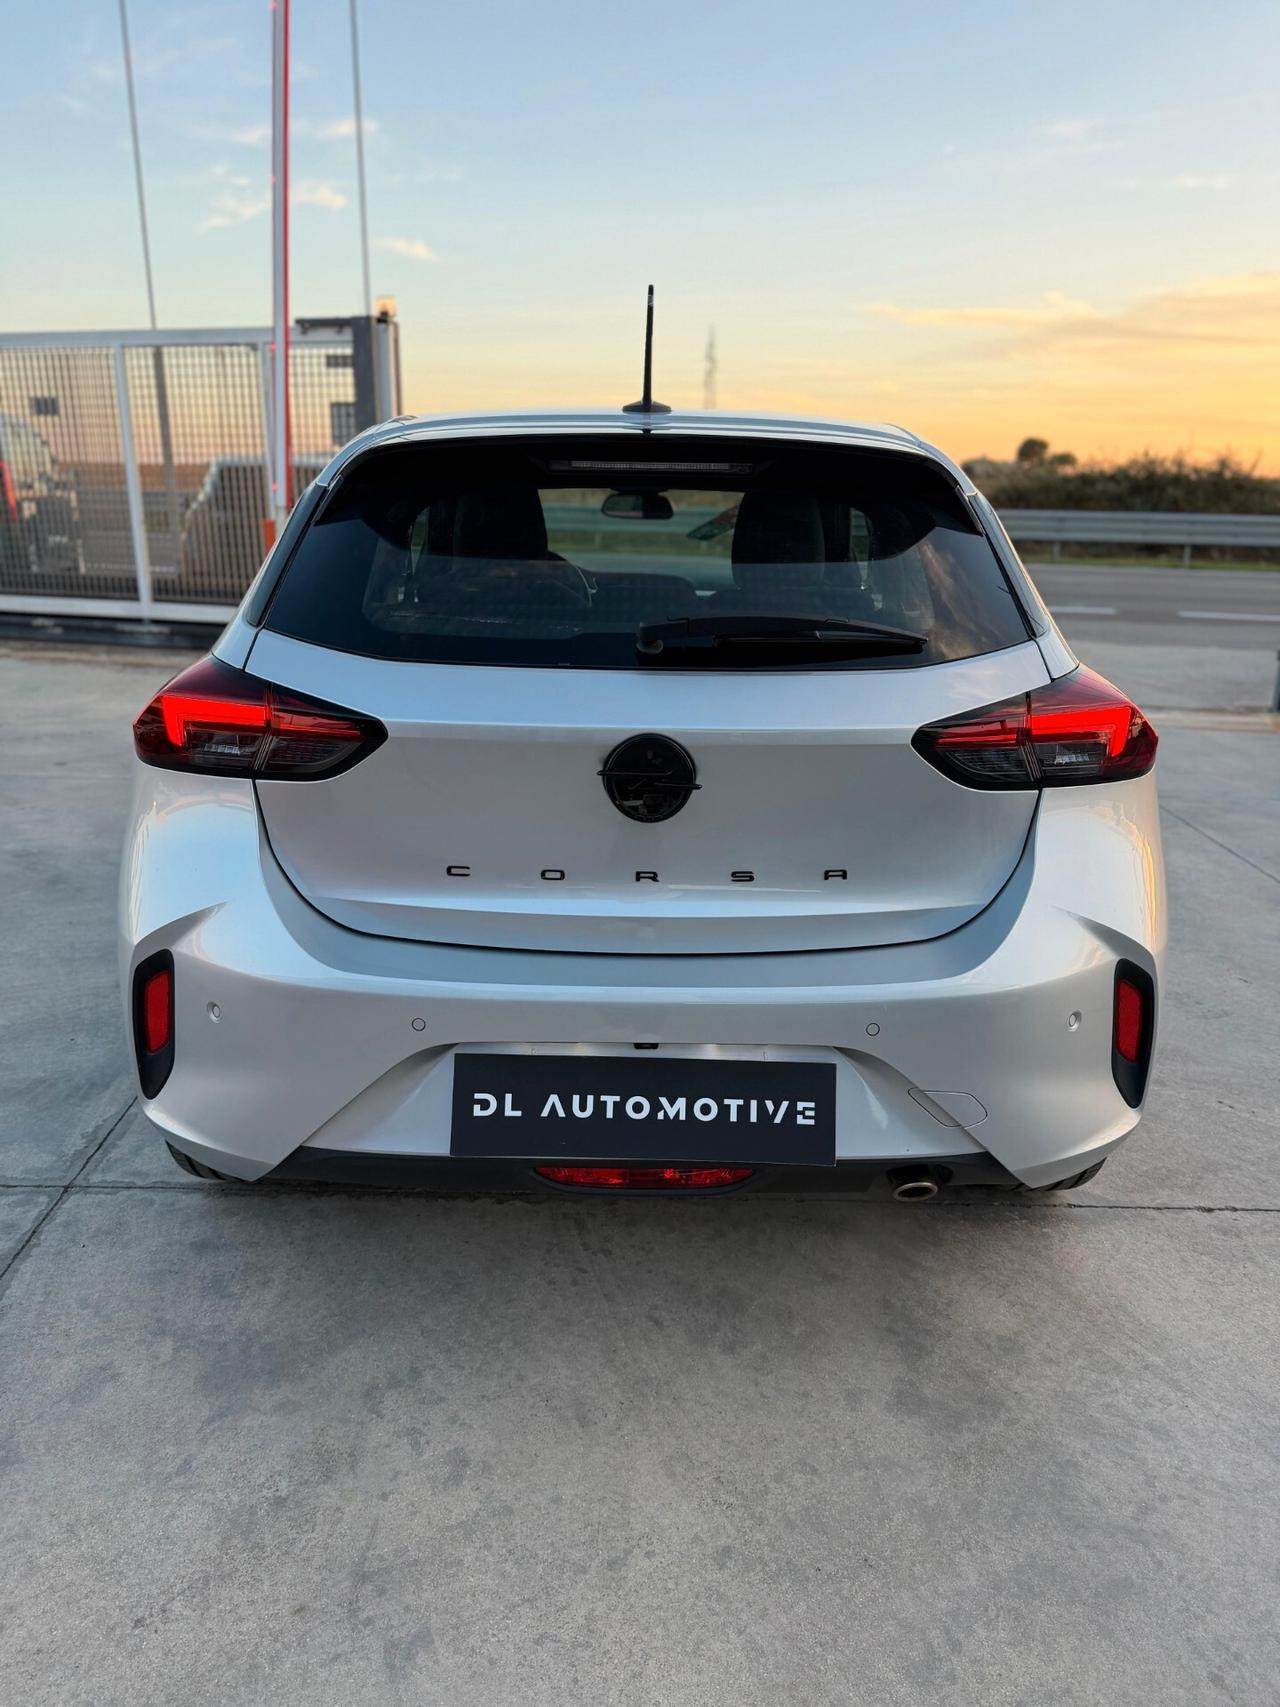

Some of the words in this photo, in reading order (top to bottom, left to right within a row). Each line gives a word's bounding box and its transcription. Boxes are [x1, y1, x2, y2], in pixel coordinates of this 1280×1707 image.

[446, 865, 848, 883] CORSA
[473, 1092, 522, 1117] DL
[540, 1093, 816, 1126] AUTOMOTIVE
